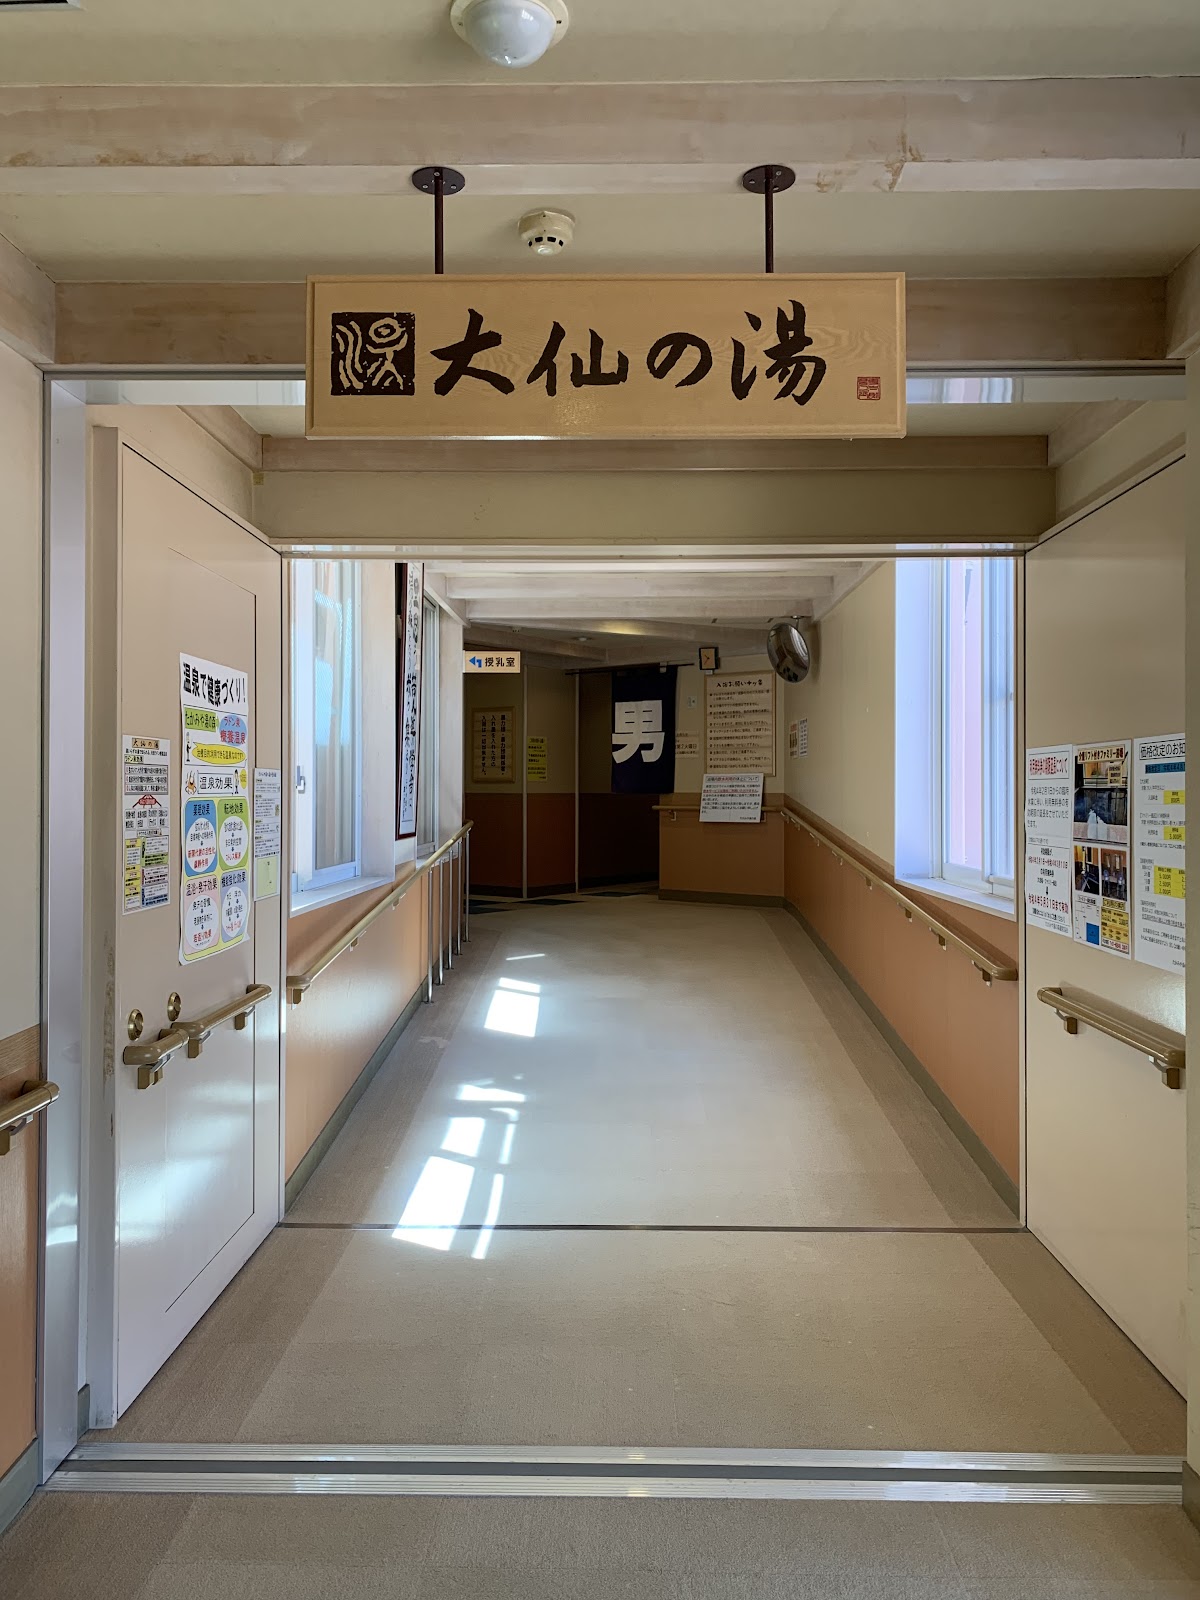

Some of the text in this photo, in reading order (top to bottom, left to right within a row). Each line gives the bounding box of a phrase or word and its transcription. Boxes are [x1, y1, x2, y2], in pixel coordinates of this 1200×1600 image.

[430, 300, 827, 405] 大仙の湯
[485, 657, 516, 667] 授乳室
[183, 662, 246, 707] 温泉で健康づくり!
[220, 730, 246, 744] 療養温泉
[612, 699, 665, 763] 男
[200, 777, 234, 790] 温泉効果
